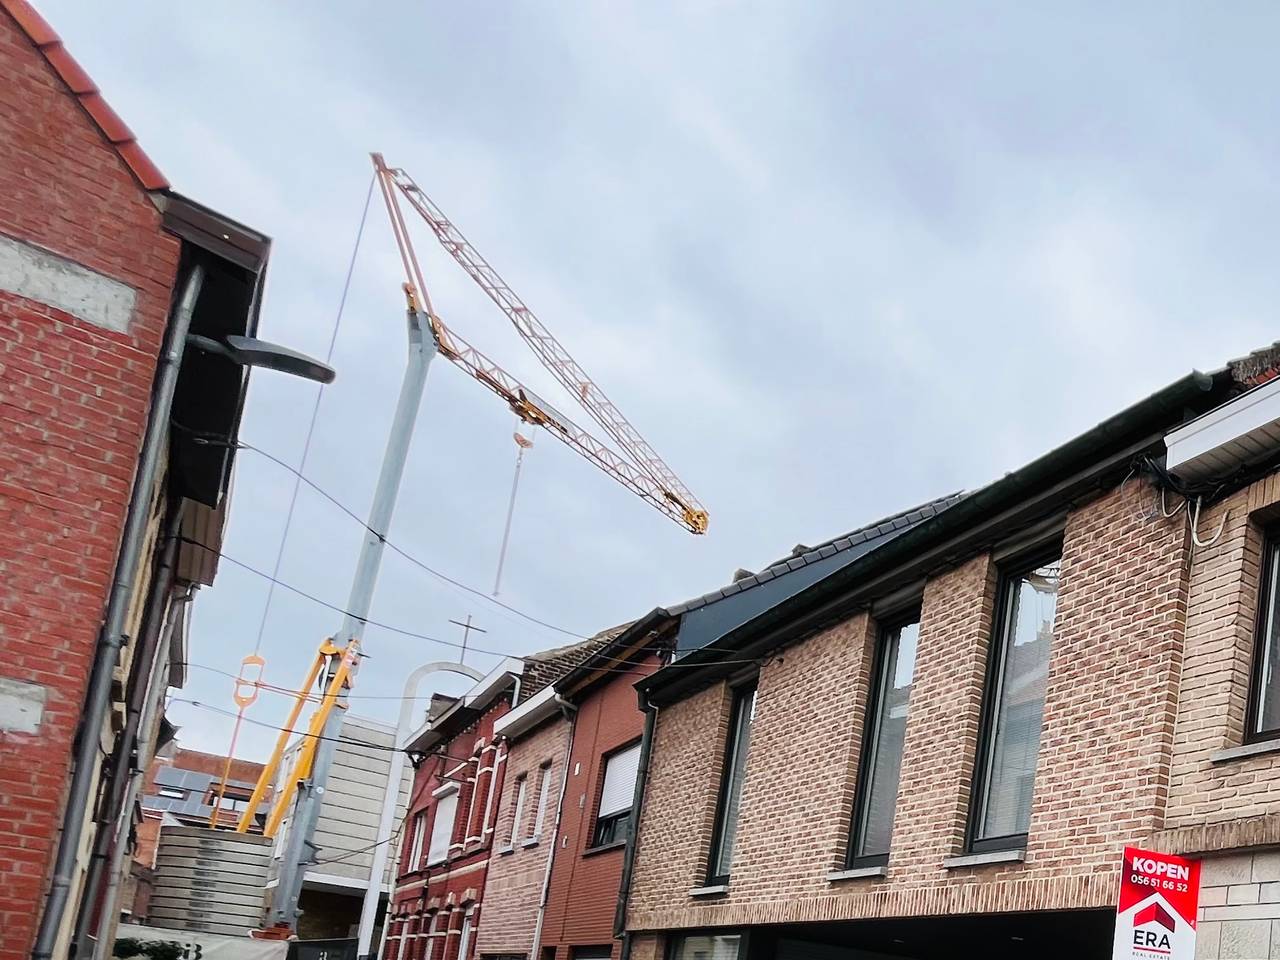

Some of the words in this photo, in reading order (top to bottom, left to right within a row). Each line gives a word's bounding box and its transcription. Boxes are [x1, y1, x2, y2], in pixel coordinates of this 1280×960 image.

[1132, 856, 1189, 881] KOPEN
[1131, 874, 1150, 885] 056
[1150, 877, 1161, 887] 51
[1162, 880, 1174, 890] 66
[1176, 882, 1188, 892] 52
[1133, 929, 1171, 949] ERA
